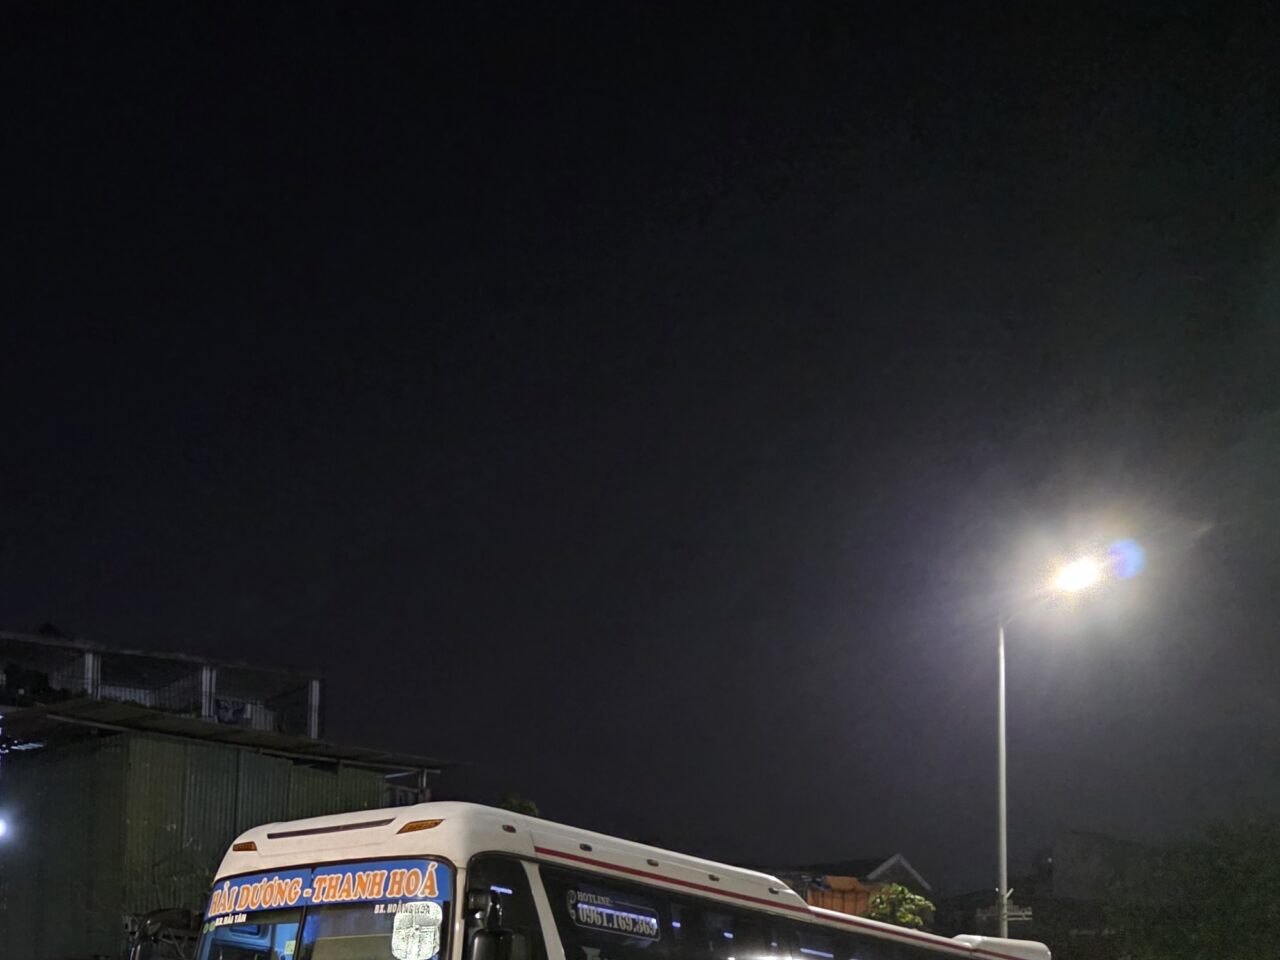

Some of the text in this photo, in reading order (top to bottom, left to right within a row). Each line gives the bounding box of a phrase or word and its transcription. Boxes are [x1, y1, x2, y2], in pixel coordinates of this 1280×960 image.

[209, 881, 237, 917] HẢI
[236, 876, 302, 911] DƯƠNG
[312, 868, 386, 902] THANH
[386, 861, 439, 899] HOÁ
